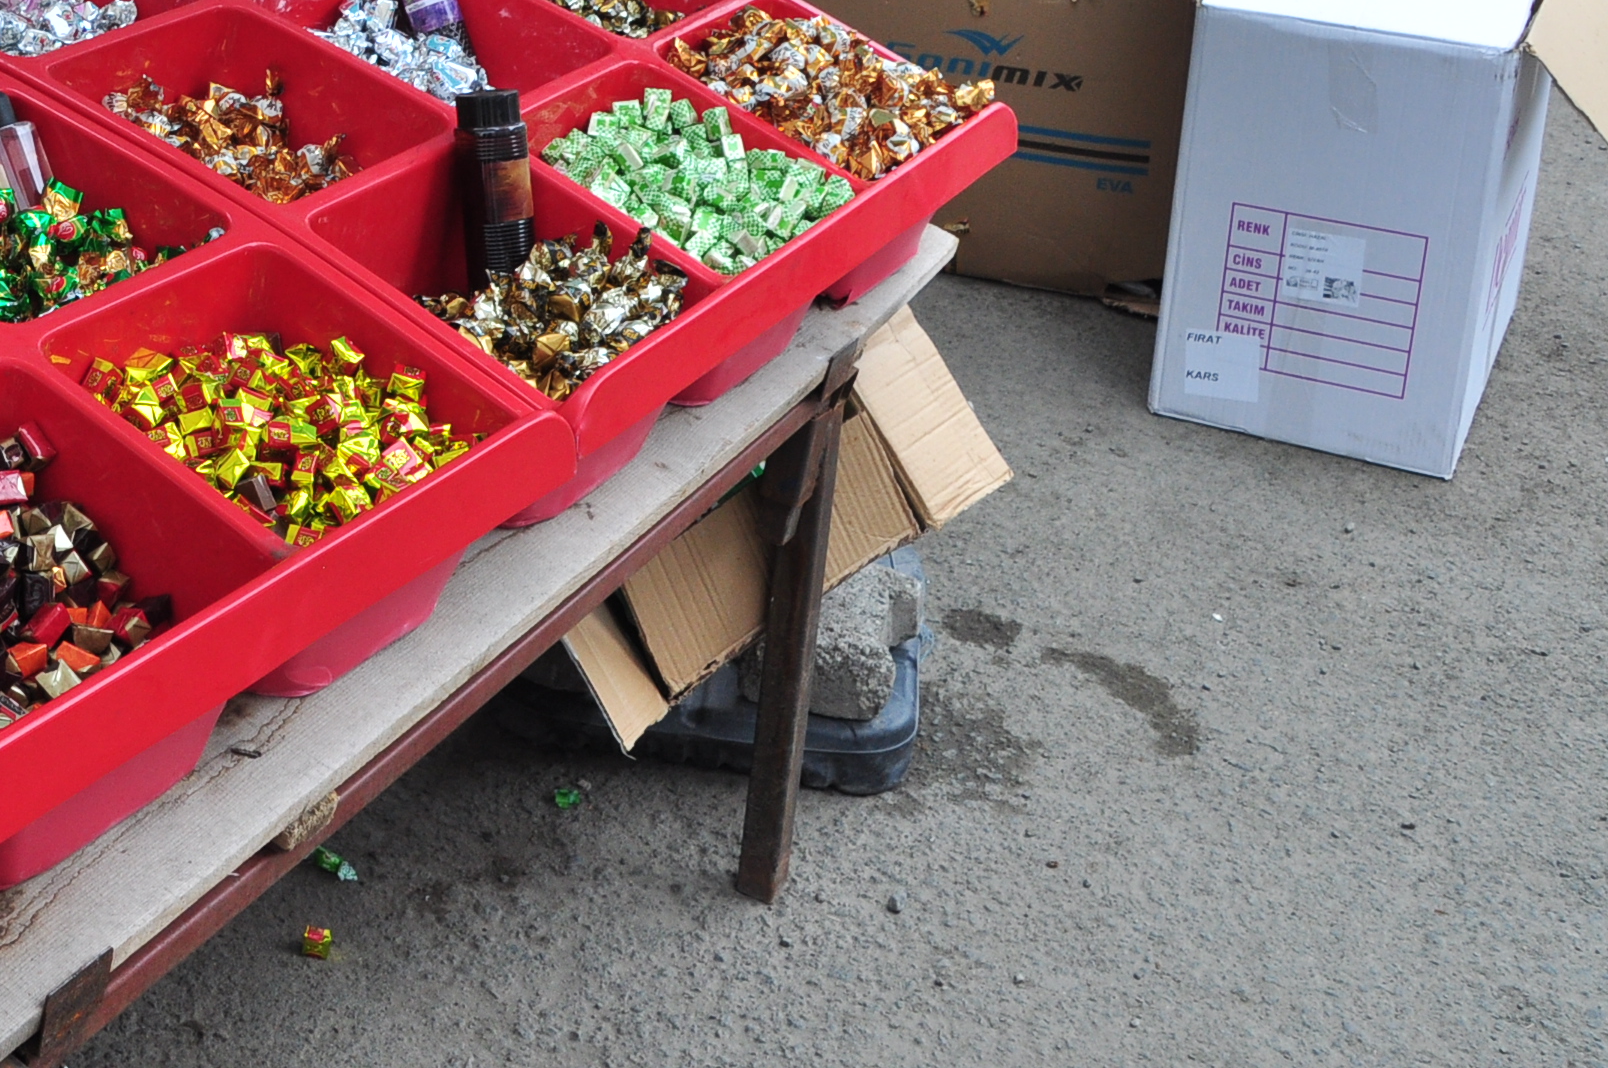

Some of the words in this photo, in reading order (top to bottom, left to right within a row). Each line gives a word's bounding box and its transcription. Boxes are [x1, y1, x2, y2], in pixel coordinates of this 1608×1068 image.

[1096, 178, 1134, 195] EVA
[1237, 220, 1271, 236] RENK
[1232, 253, 1263, 270] CİNS
[1229, 276, 1261, 293] ADET
[1227, 299, 1265, 317] TAKIM
[1186, 332, 1222, 345] FIRAT
[1224, 321, 1266, 340] KALİTE
[1185, 369, 1219, 382] KARS
